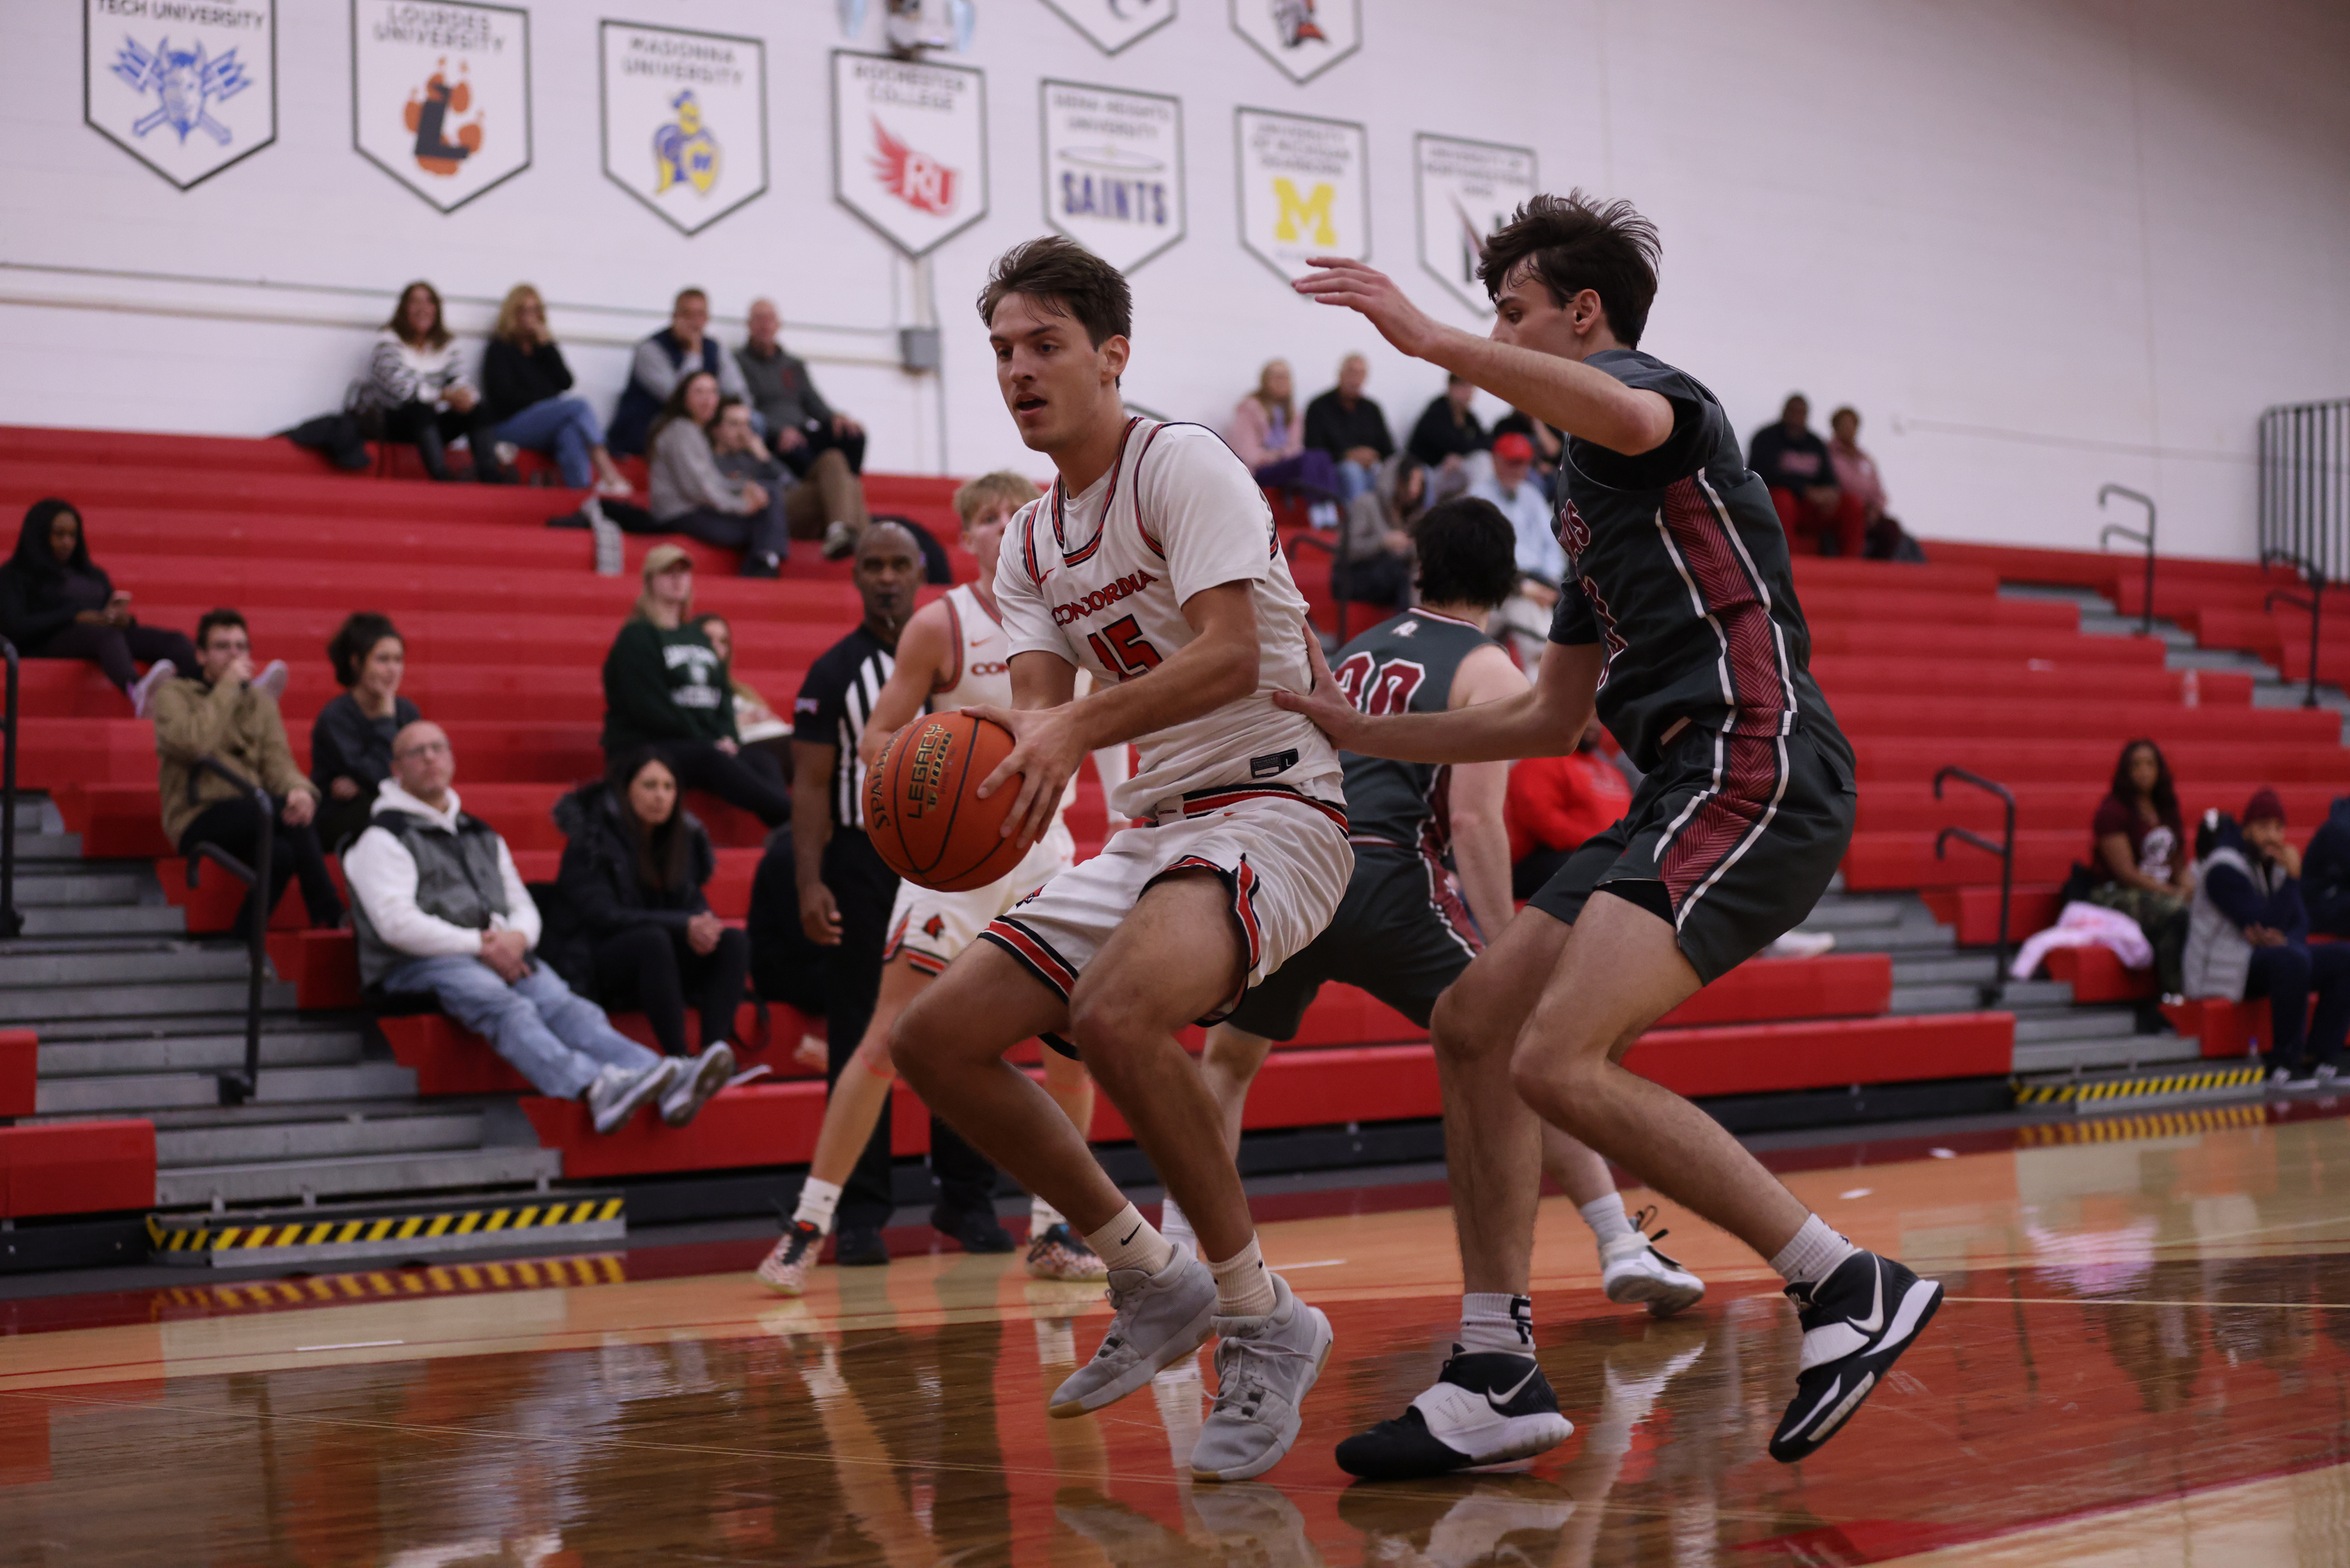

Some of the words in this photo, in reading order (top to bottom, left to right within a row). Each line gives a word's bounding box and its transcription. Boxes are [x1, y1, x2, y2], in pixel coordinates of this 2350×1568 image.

[96, 0, 146, 16] TECH
[152, 2, 264, 29] UNIVERSITY
[387, 6, 491, 31] LOURDES
[373, 22, 504, 51] UNIVERSITY
[630, 37, 737, 63] MADONNA
[621, 57, 744, 86] UNIVERSITY
[855, 63, 966, 91] ROCHESTER
[866, 83, 955, 113] COLLEGE
[1062, 172, 1166, 225] SAINTS
[1274, 178, 1336, 245] M
[1087, 613, 1163, 682] 15
[908, 724, 944, 818] LEGACY
[929, 733, 952, 786] 1000
